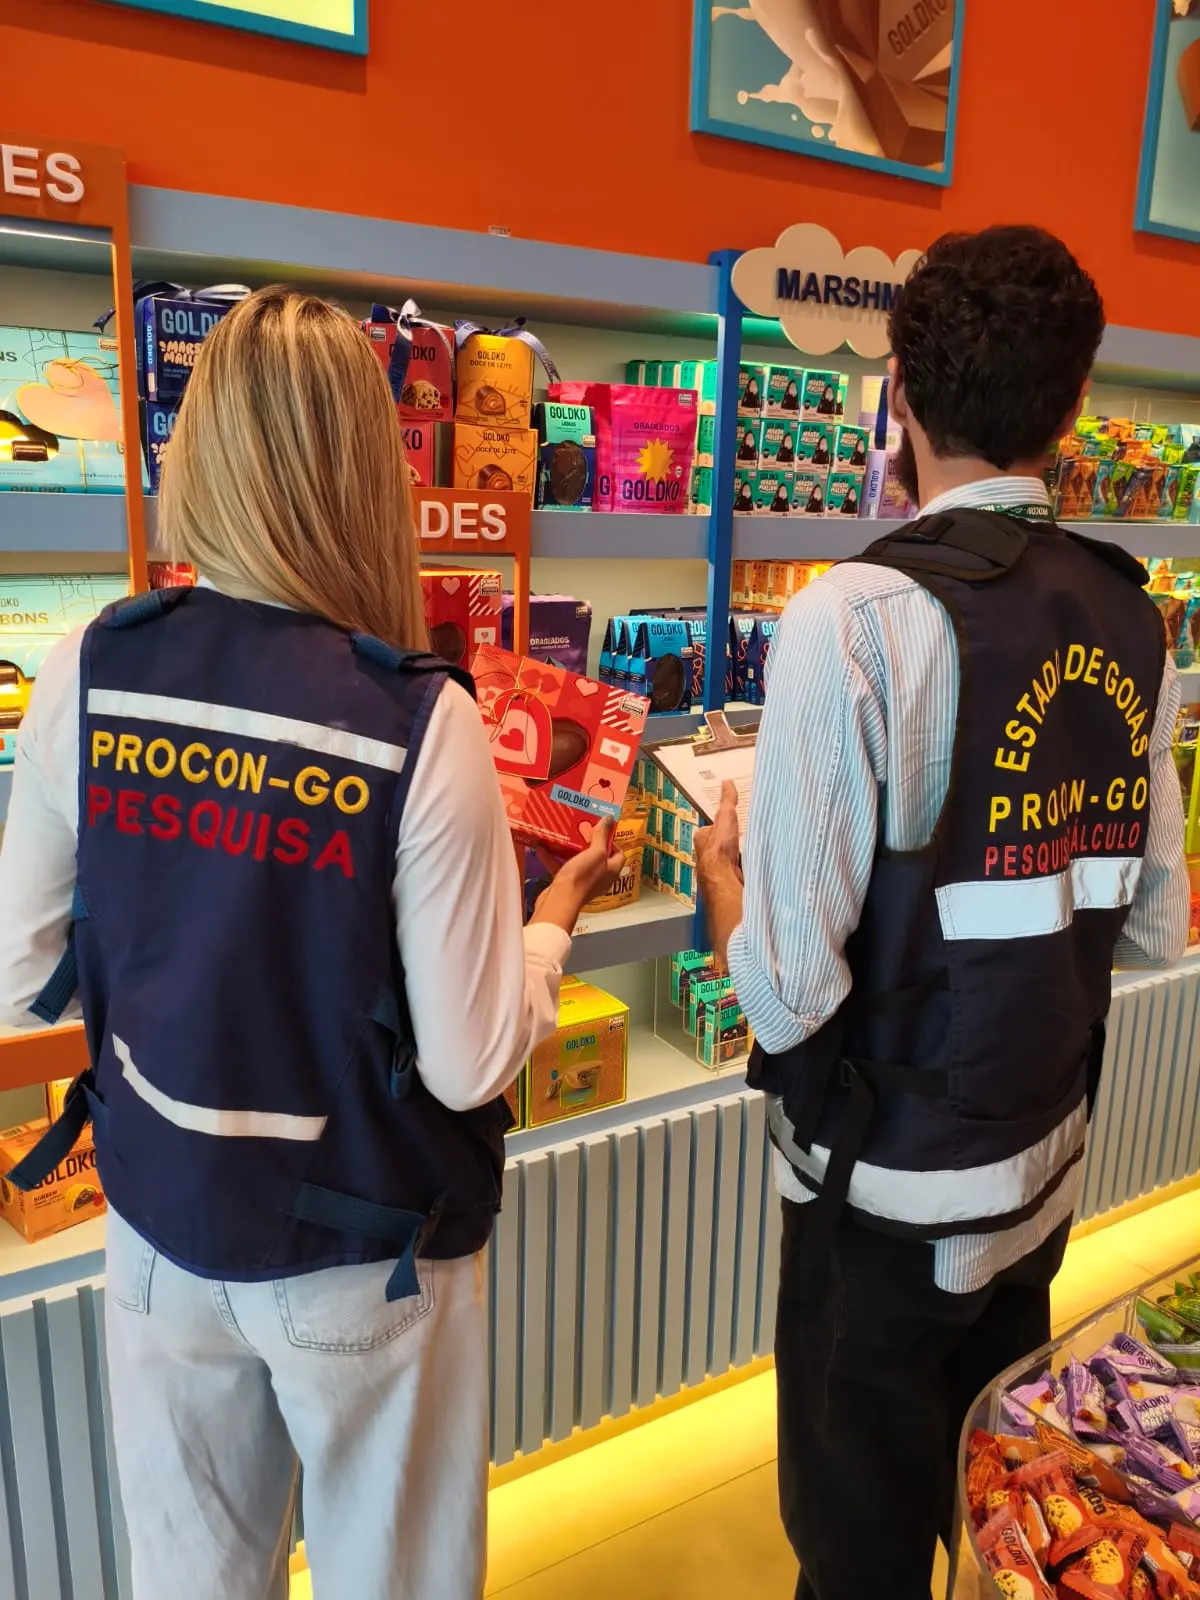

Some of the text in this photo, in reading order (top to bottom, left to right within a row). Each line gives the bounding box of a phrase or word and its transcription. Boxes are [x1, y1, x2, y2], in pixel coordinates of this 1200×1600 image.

[161, 308, 224, 337] GOLD
[477, 350, 506, 361] GOLDKO
[550, 406, 586, 421] GOLDKO
[483, 432, 510, 442] GOLDKO
[622, 479, 680, 502] GOLDKO
[420, 500, 507, 541] DES
[651, 623, 683, 636] GOLDKO
[1064, 644, 1104, 686] DE
[1104, 660, 1149, 758] GOIÁS
[91, 730, 370, 815] PROCON-GO
[557, 789, 591, 808] GOLDKO
[87, 784, 356, 879] PESQUISA
[984, 818, 1141, 876] PESQUIS ÁLCULO
[700, 978, 731, 994] GOLDKO
[566, 1034, 596, 1050] GOLDKO
[33, 1149, 97, 1190] OLDKO
[1001, 1527, 1028, 1566] GOLDKO
